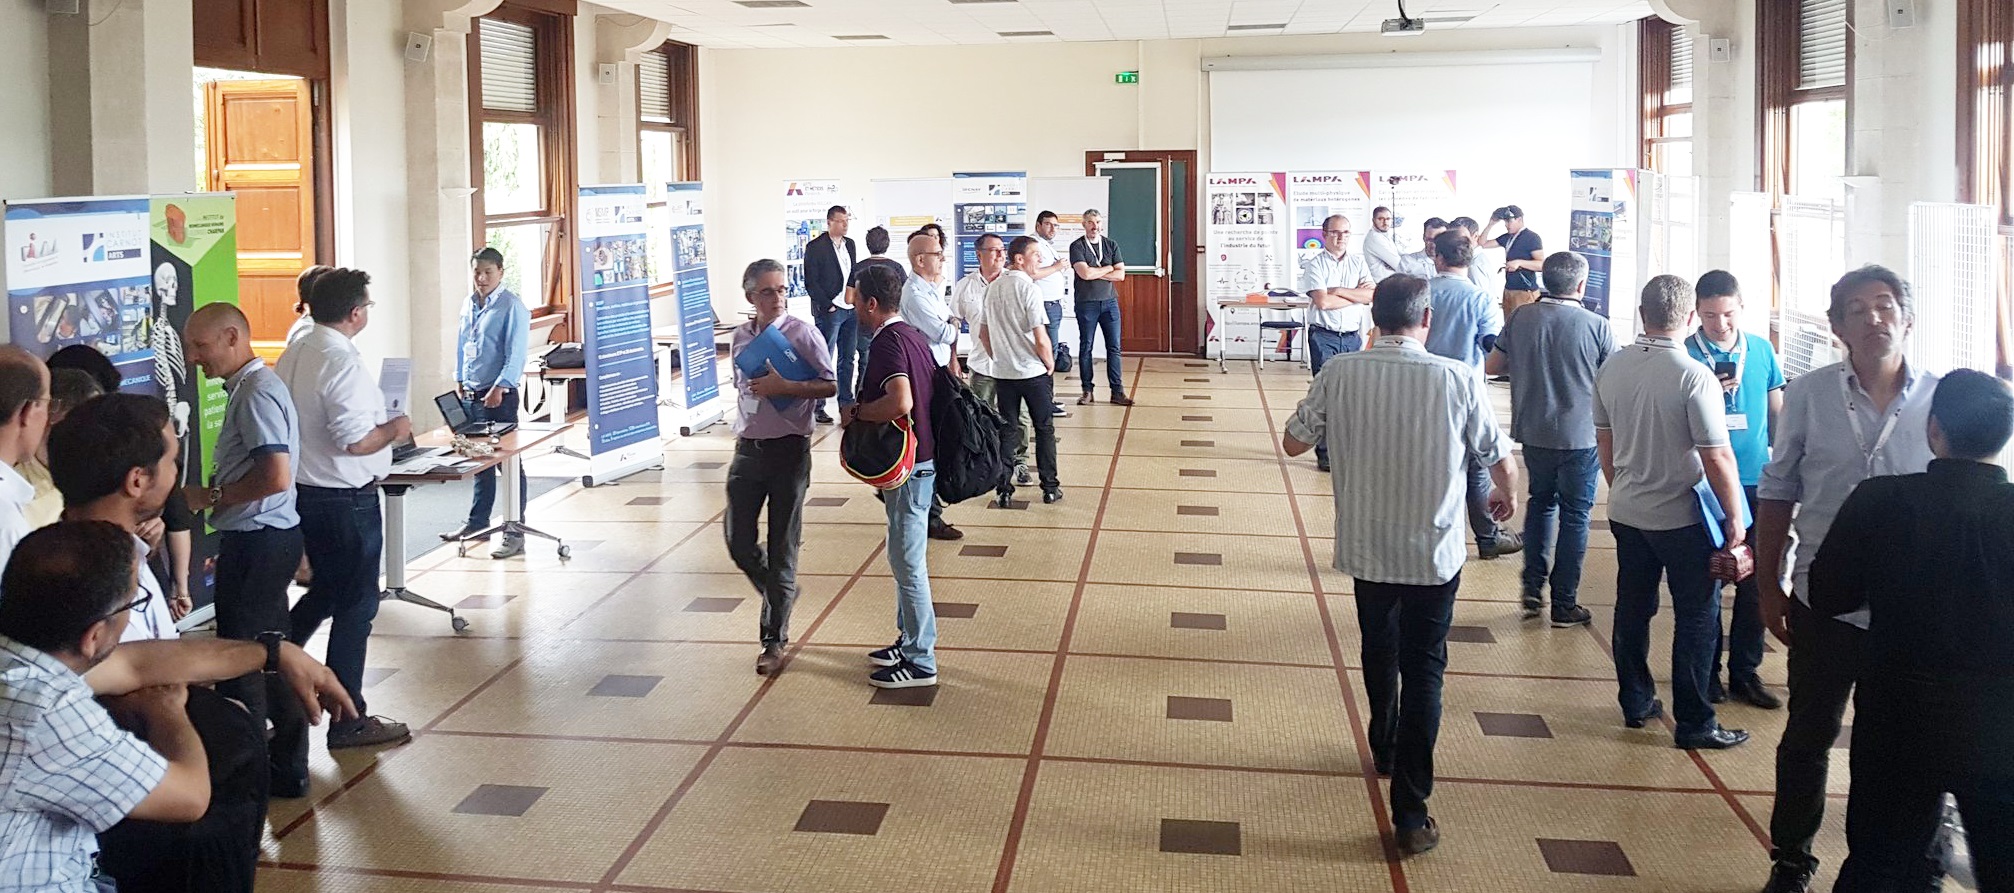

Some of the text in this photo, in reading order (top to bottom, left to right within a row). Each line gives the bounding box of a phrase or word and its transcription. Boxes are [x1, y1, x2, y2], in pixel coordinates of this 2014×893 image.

[1379, 175, 1428, 183] LMPA
[106, 238, 142, 248] CARNOT
[109, 251, 124, 259] ARTS
[207, 389, 228, 402] servic
